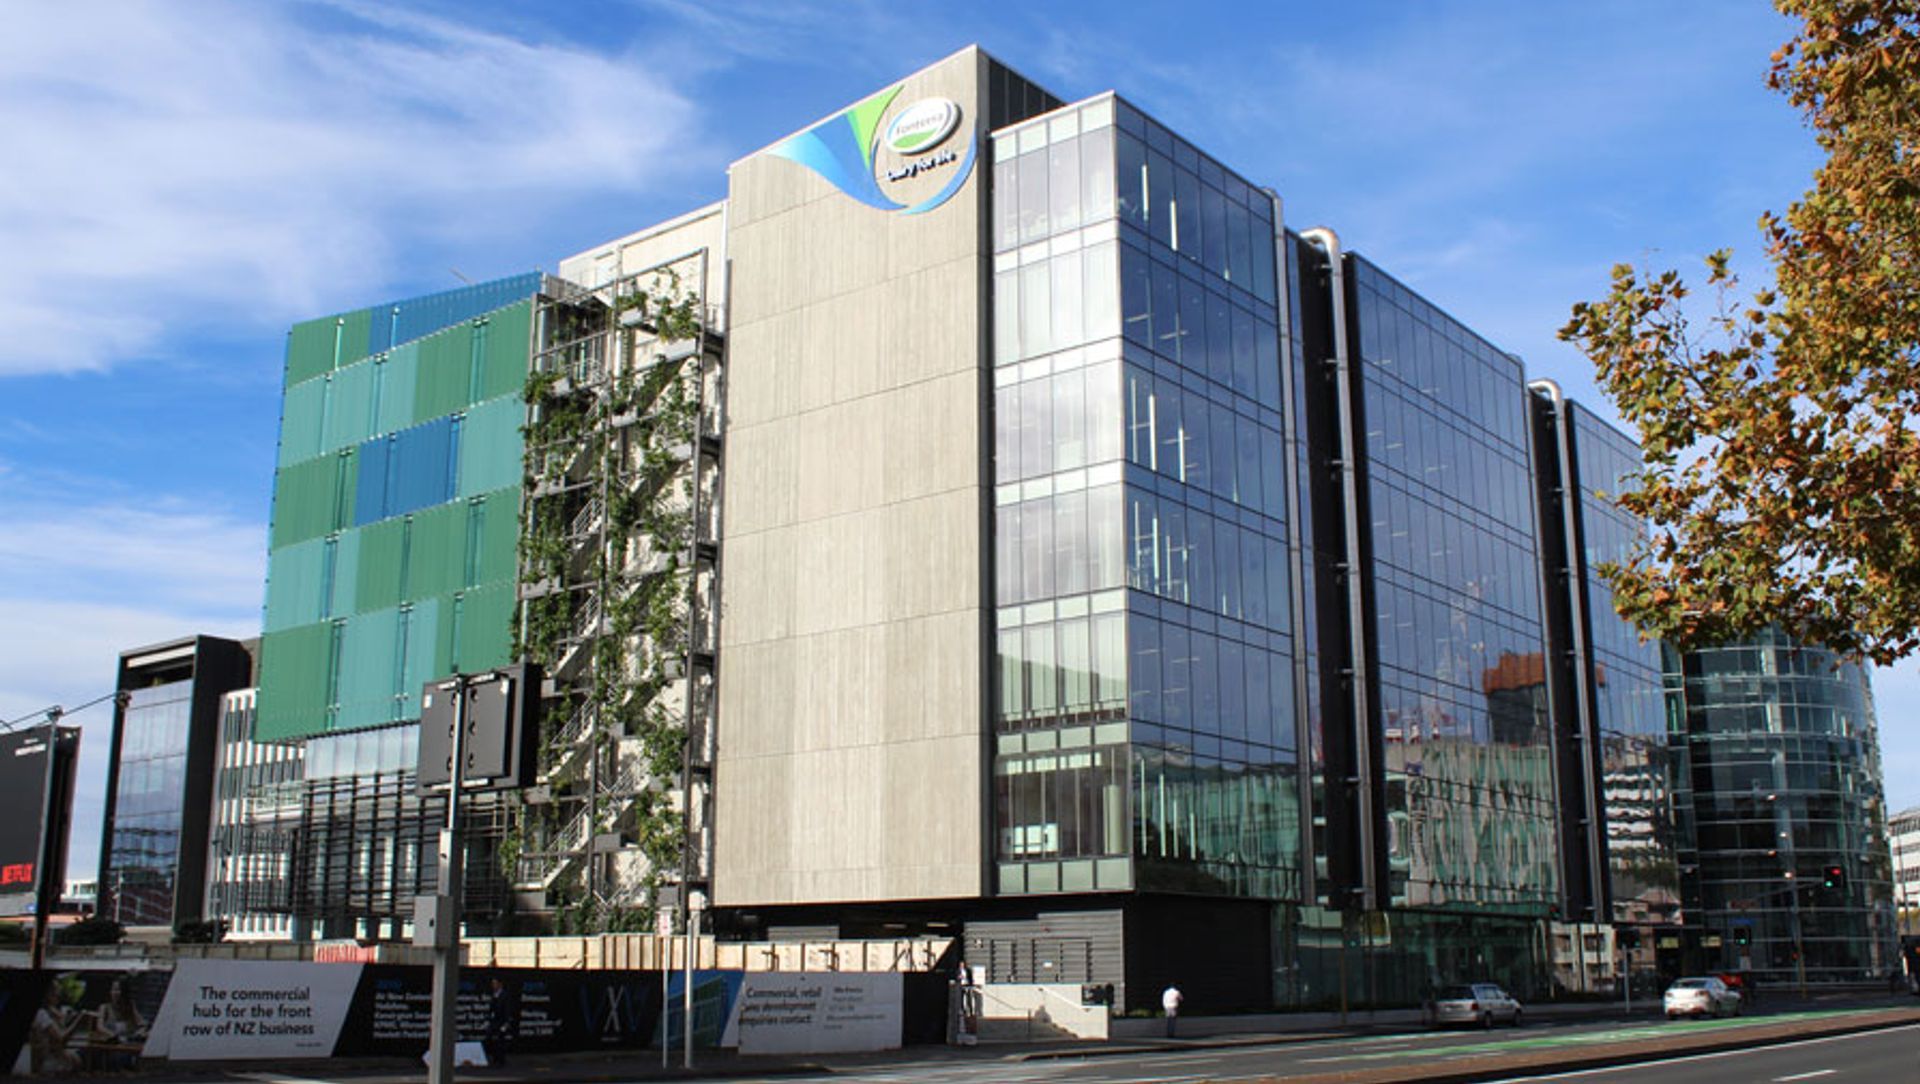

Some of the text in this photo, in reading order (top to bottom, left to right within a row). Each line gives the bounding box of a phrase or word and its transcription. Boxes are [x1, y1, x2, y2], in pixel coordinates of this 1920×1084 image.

[199, 986, 310, 1000] The commercial
[193, 1003, 312, 1017] hub for the front
[183, 1020, 315, 1036] row of NZ business
